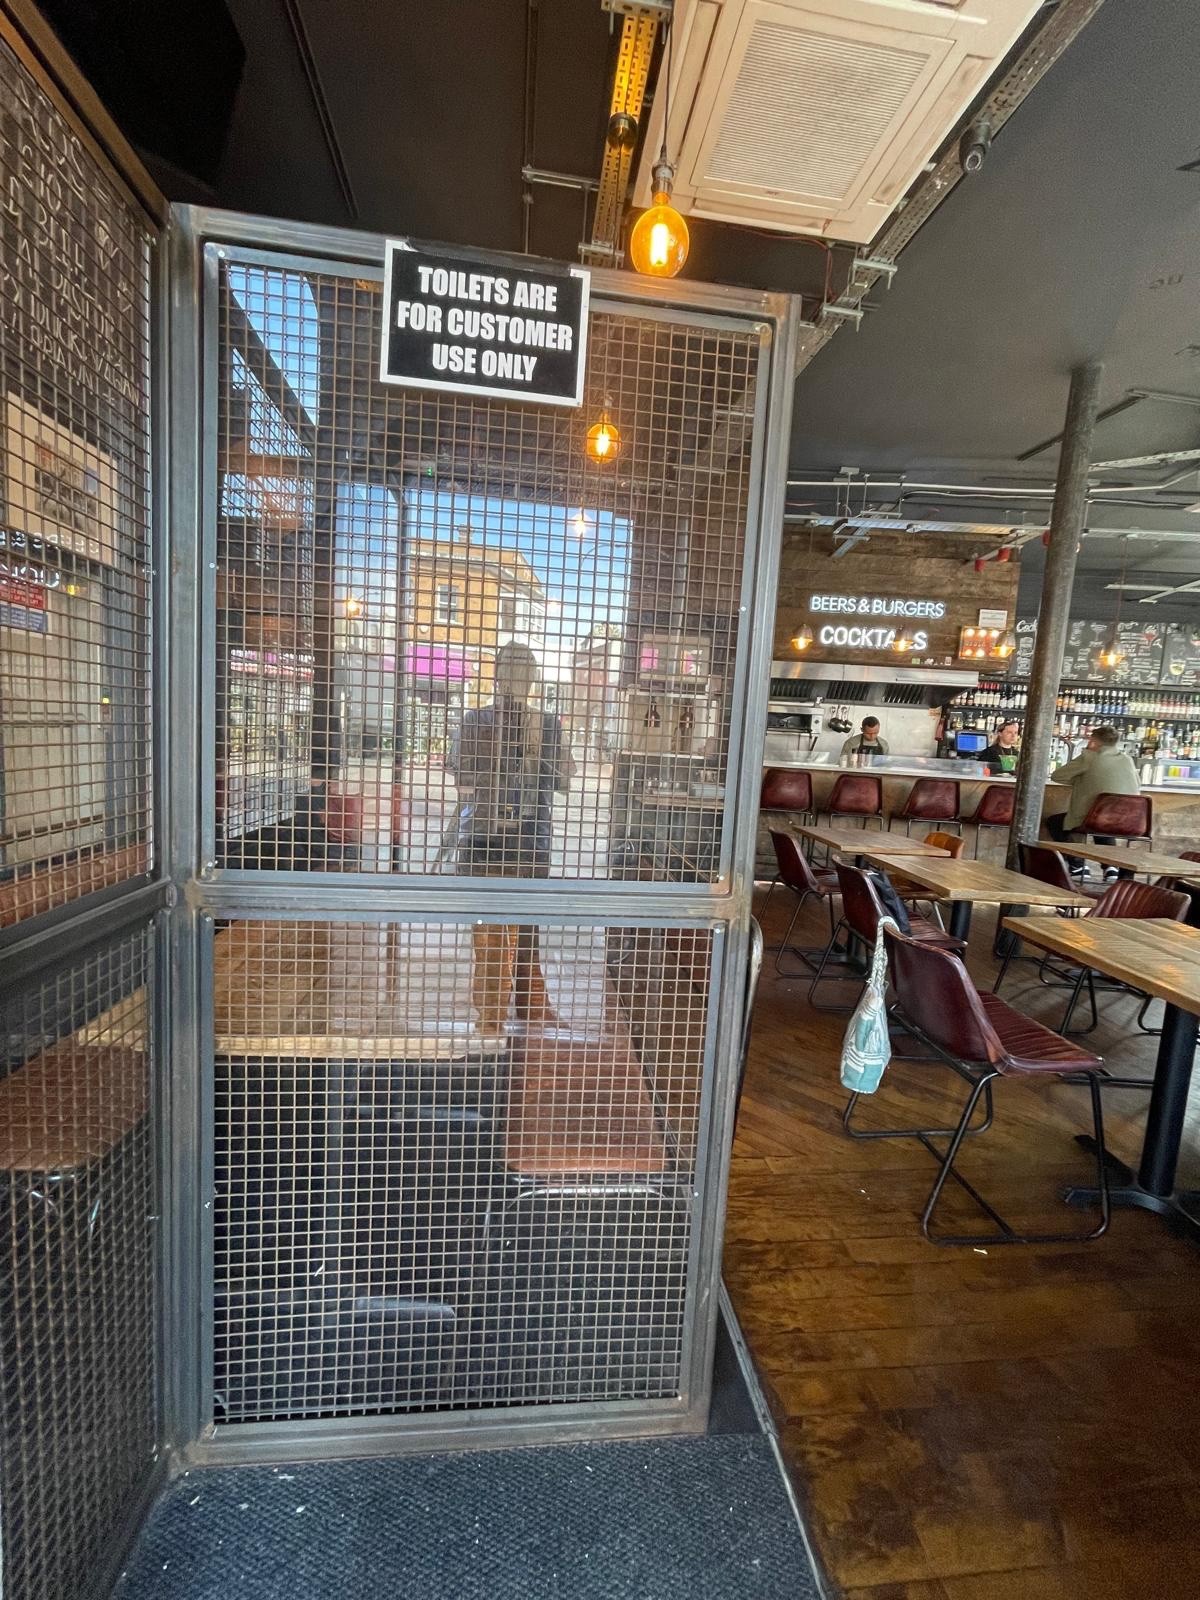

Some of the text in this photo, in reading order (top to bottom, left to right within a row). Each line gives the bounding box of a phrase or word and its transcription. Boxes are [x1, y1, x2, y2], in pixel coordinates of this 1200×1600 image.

[418, 266, 558, 312] TOILETS ARE
[397, 300, 573, 351] FOR CUSTOMER
[432, 343, 537, 381] USE ONLY
[810, 595, 945, 617] BEERS & BURGERS
[820, 625, 928, 651] COCKTAS
